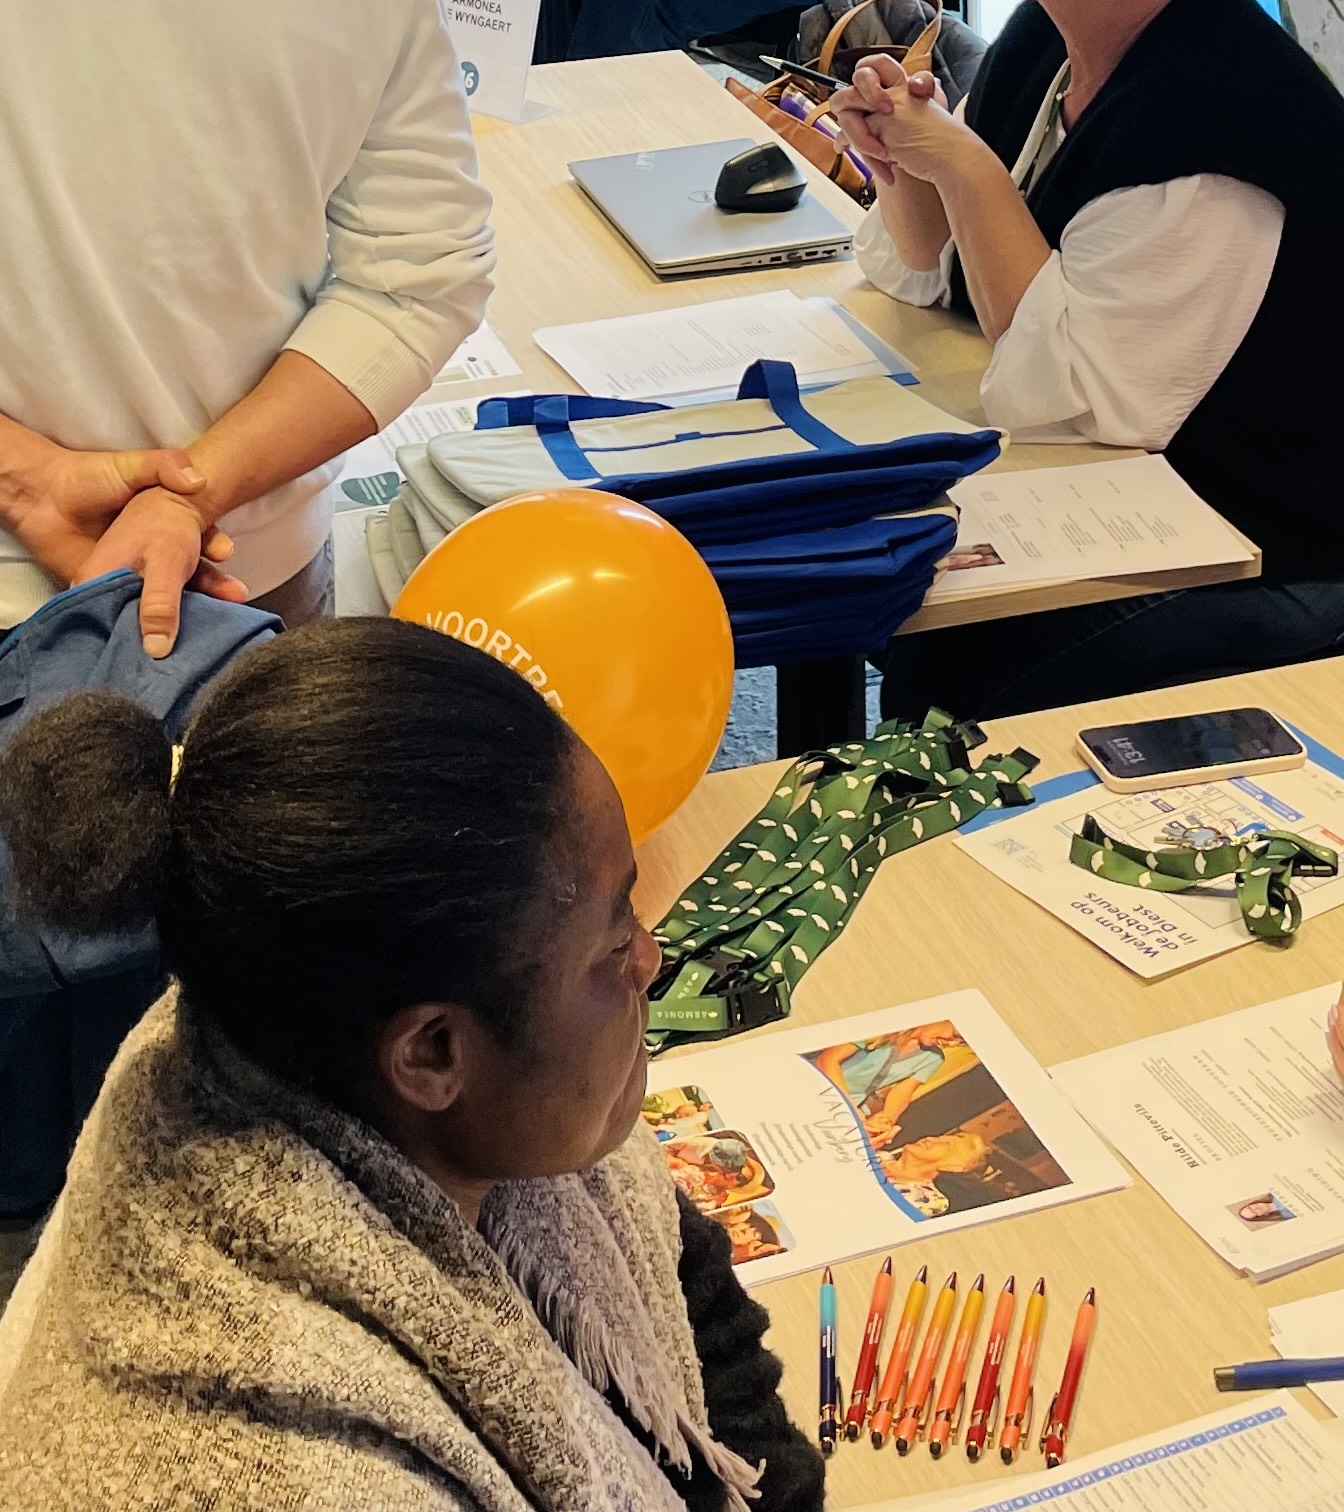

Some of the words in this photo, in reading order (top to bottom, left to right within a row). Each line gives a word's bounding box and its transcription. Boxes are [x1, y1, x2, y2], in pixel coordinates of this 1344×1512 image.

[455, 10, 513, 34] WYNGAERT
[1070, 901, 1094, 916] op
[1084, 891, 1163, 937] jobbeurs
[1132, 903, 1178, 933] Diest
[1095, 916, 1160, 958] Welkom
[1155, 936, 1179, 950] de
[1177, 932, 1199, 946] in
